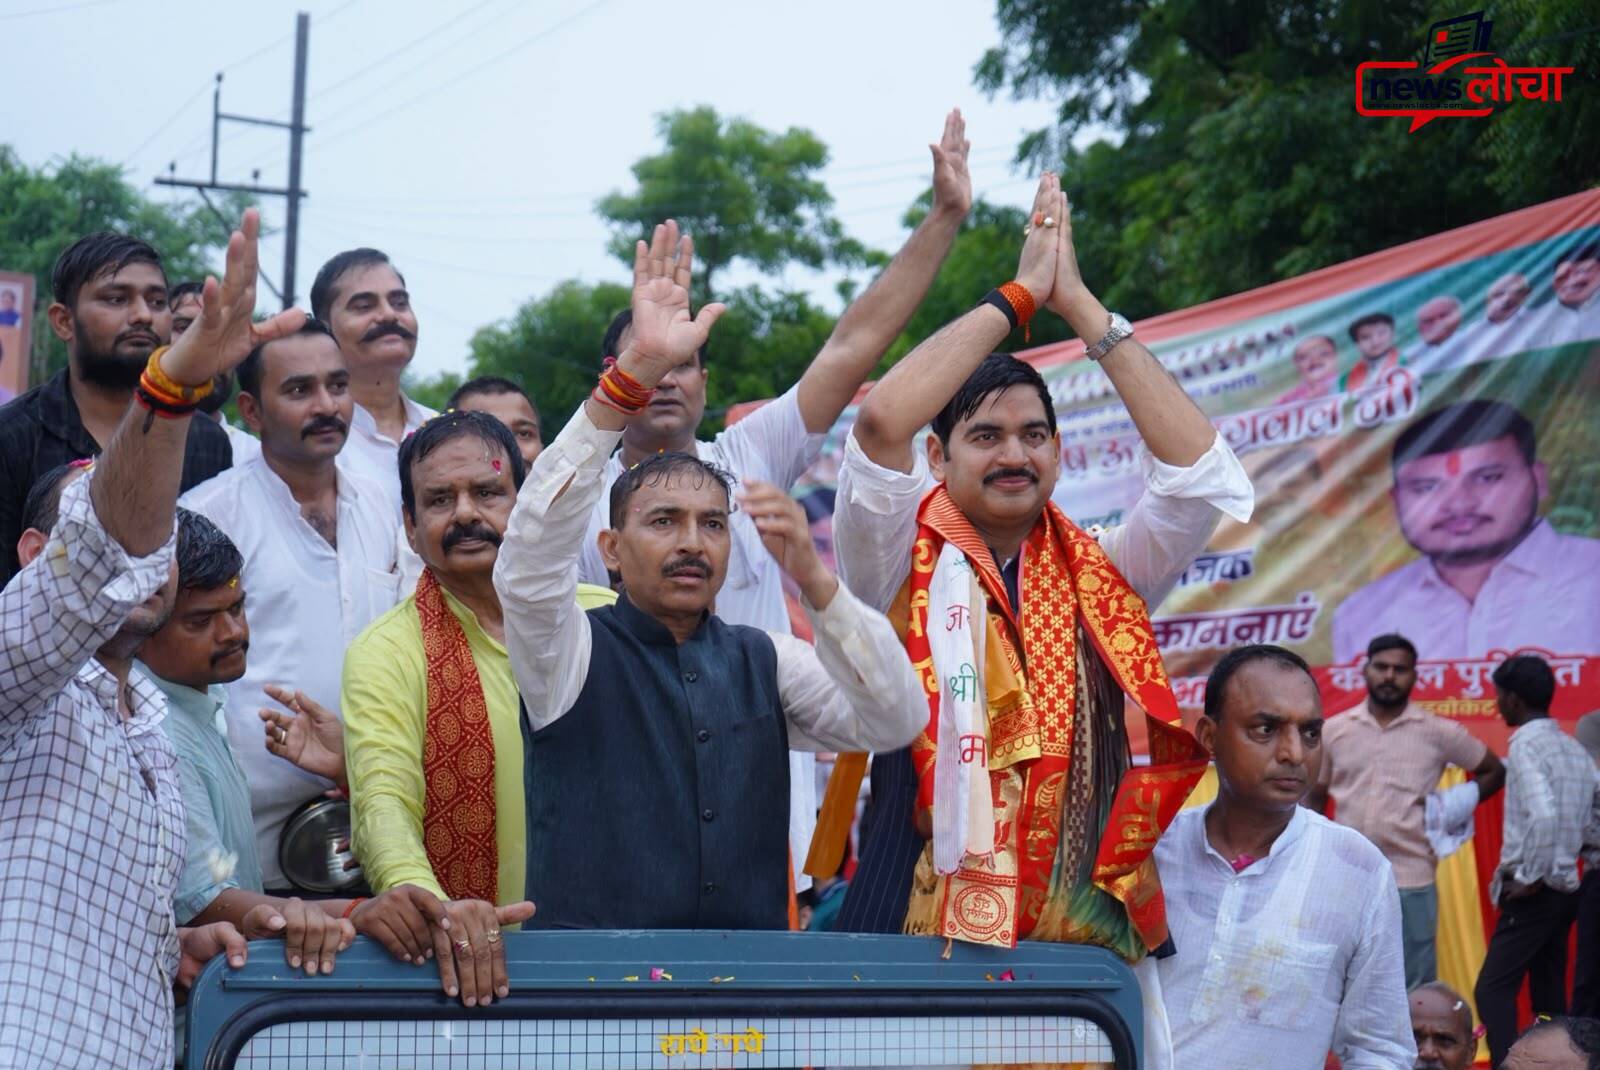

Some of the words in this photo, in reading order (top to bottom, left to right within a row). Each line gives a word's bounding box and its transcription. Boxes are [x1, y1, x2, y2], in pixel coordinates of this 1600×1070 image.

[1150, 594, 1318, 650] कामनाएं
[949, 662, 978, 702] श्री
[657, 1027, 709, 1056] राधे
